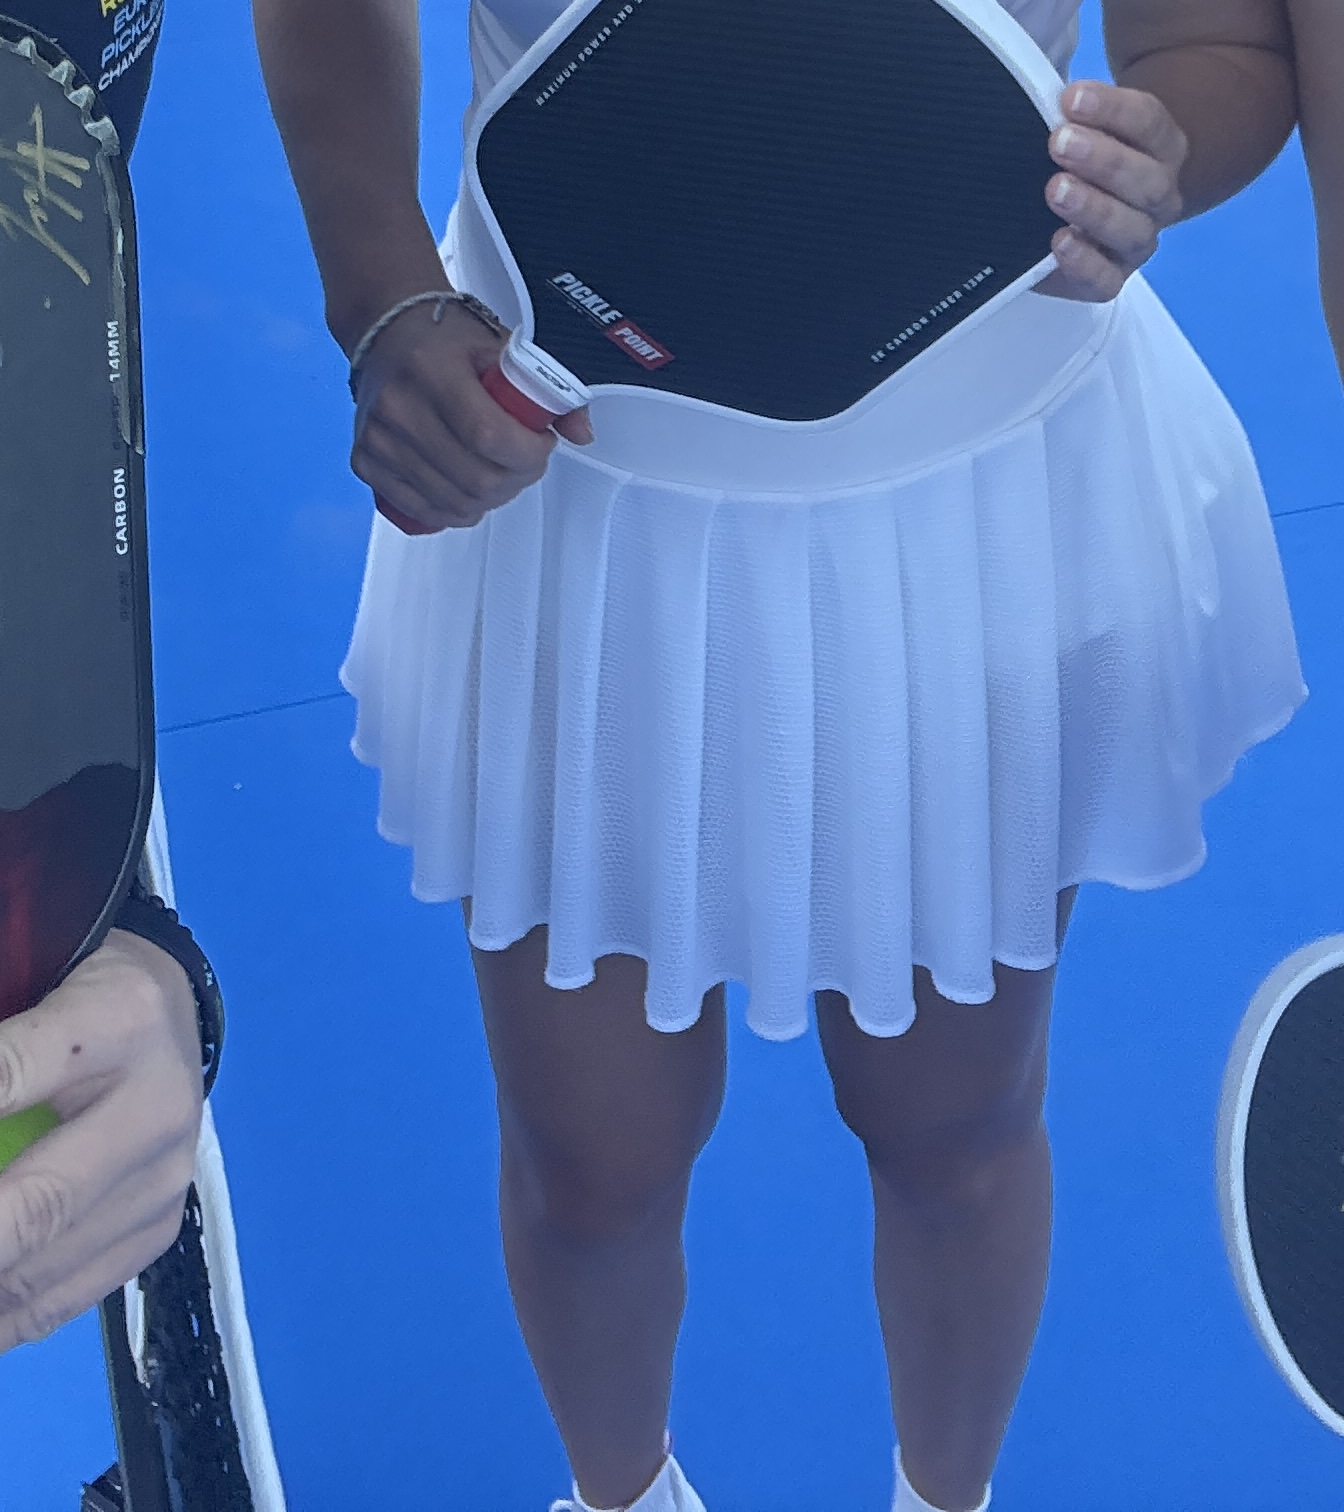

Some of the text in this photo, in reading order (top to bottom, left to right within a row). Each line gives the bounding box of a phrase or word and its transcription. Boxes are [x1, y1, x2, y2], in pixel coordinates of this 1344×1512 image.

[578, 27, 612, 62] POWER
[612, 4, 634, 28] AND
[552, 272, 665, 362] PICKLE POINT
[886, 316, 929, 351] CARBON
[106, 320, 120, 383] 14MM
[113, 468, 128, 556] CARBON
